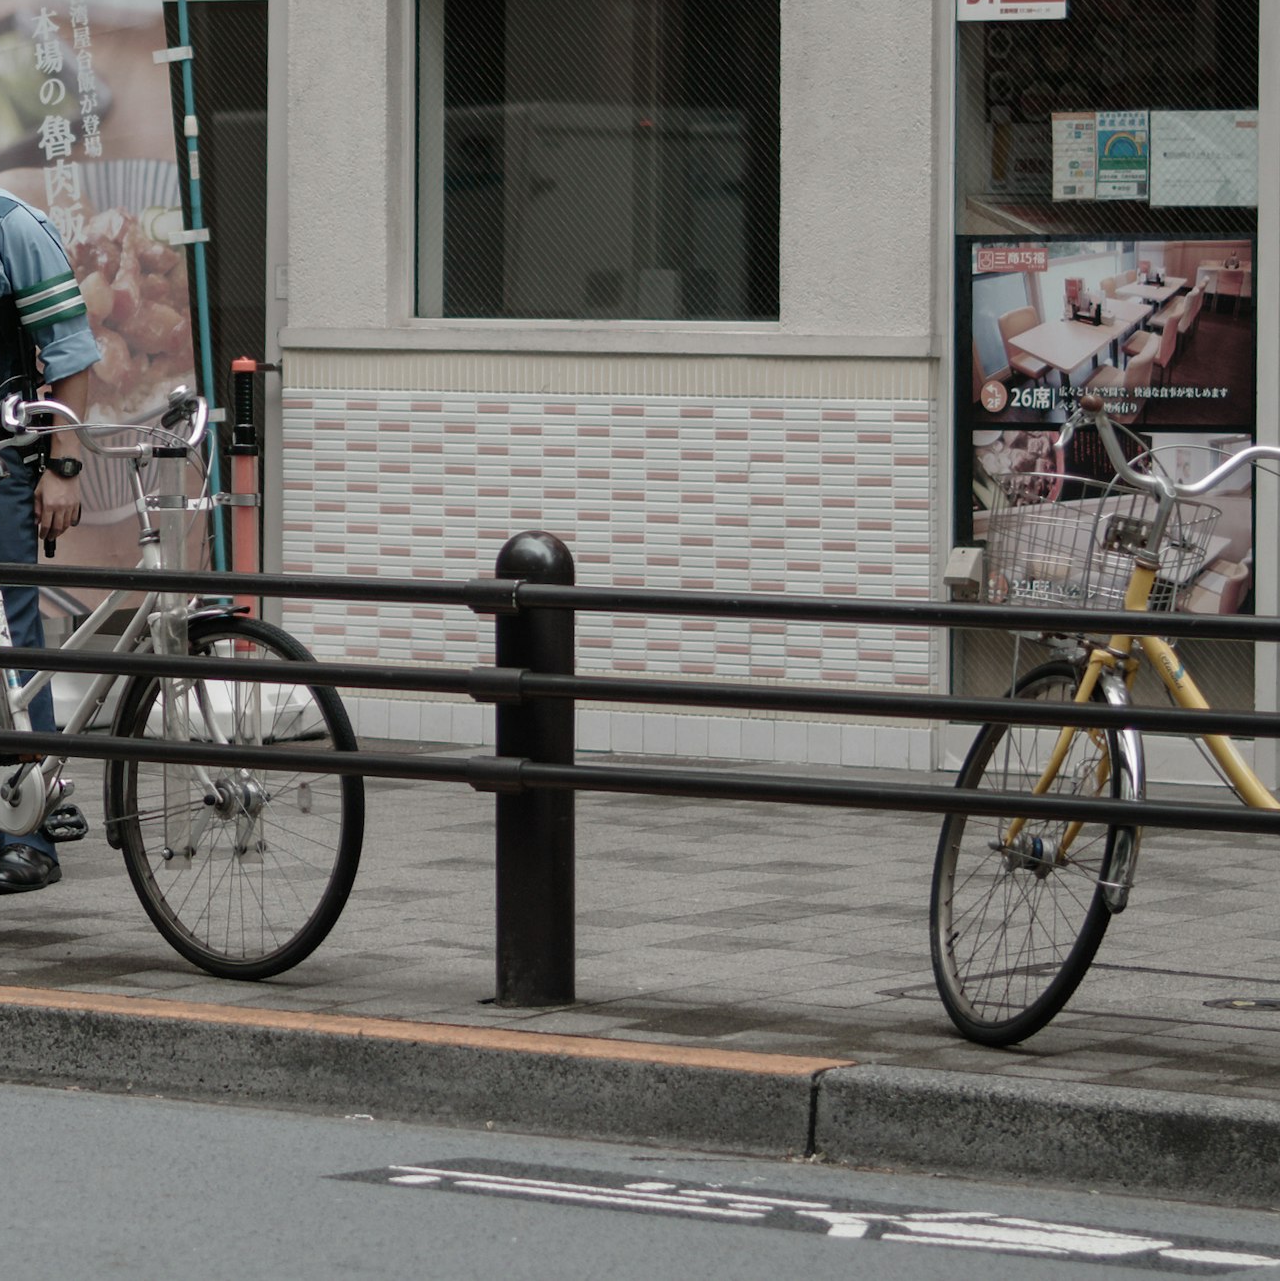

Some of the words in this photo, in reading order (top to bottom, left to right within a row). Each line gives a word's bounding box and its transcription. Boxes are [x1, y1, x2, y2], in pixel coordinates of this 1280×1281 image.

[995, 251, 1046, 265] 三商巧福
[1010, 387, 1051, 409] 26席
